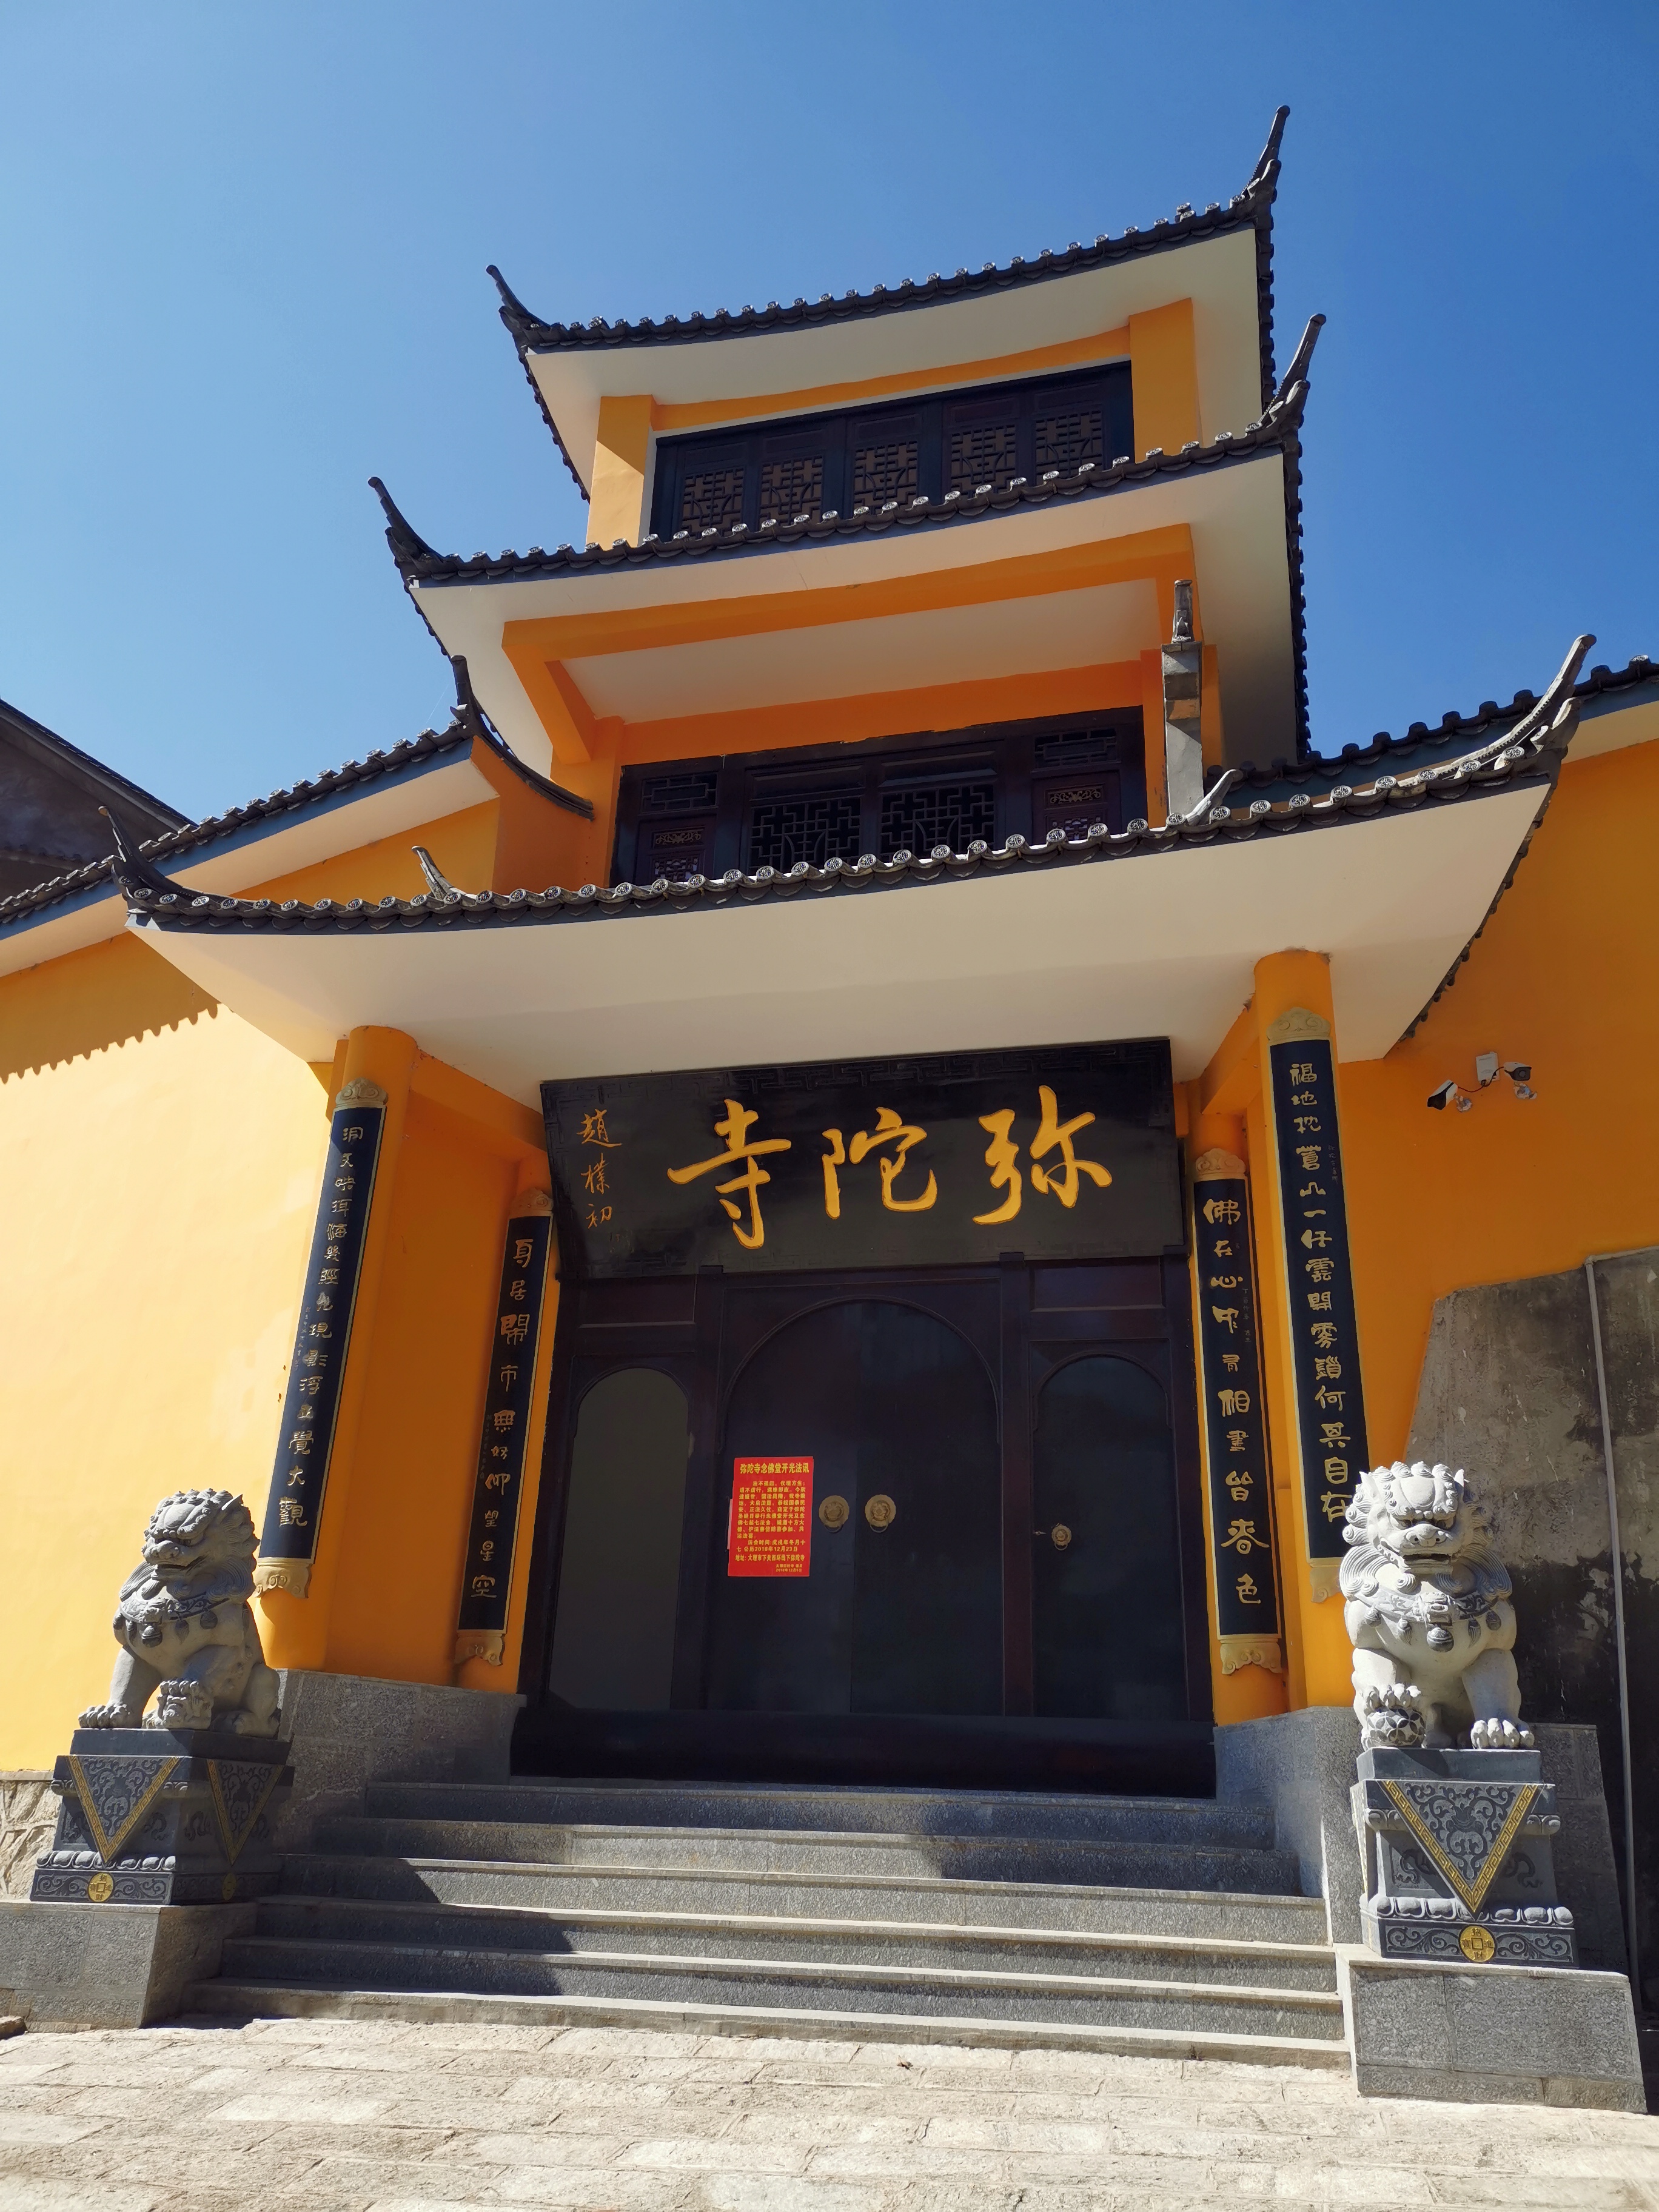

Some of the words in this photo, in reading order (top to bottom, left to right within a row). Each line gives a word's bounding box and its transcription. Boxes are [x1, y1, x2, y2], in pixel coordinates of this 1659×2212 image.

[666, 1084, 1114, 1252] 弥陀寺
[740, 1463, 809, 1474] 弥陀寺念佛堂开光法讯
